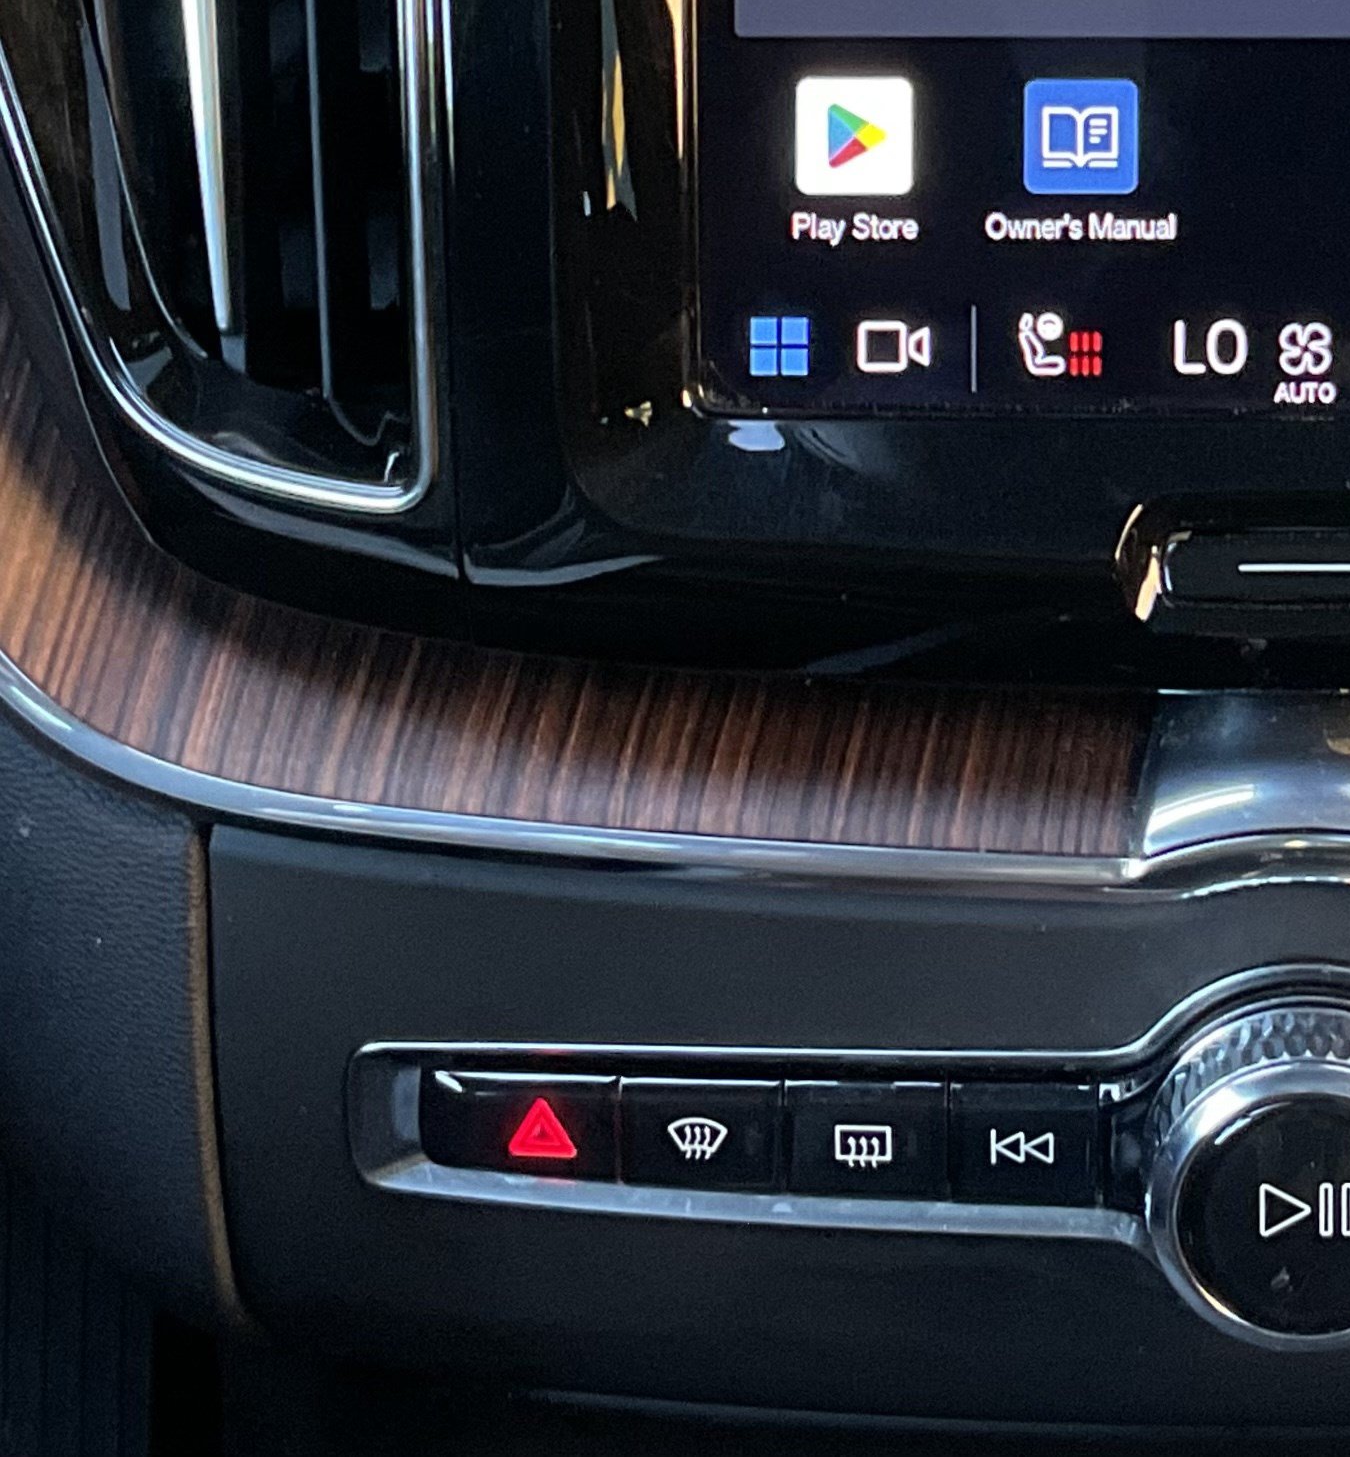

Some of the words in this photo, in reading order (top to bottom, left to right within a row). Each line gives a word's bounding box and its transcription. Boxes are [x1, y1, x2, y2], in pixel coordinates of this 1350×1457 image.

[791, 211, 847, 247] Play
[851, 211, 919, 241] Store
[984, 211, 1084, 241] Owner's
[1088, 211, 1178, 241] Manual
[1173, 318, 1248, 375] LO
[1273, 381, 1337, 405] AUTO
